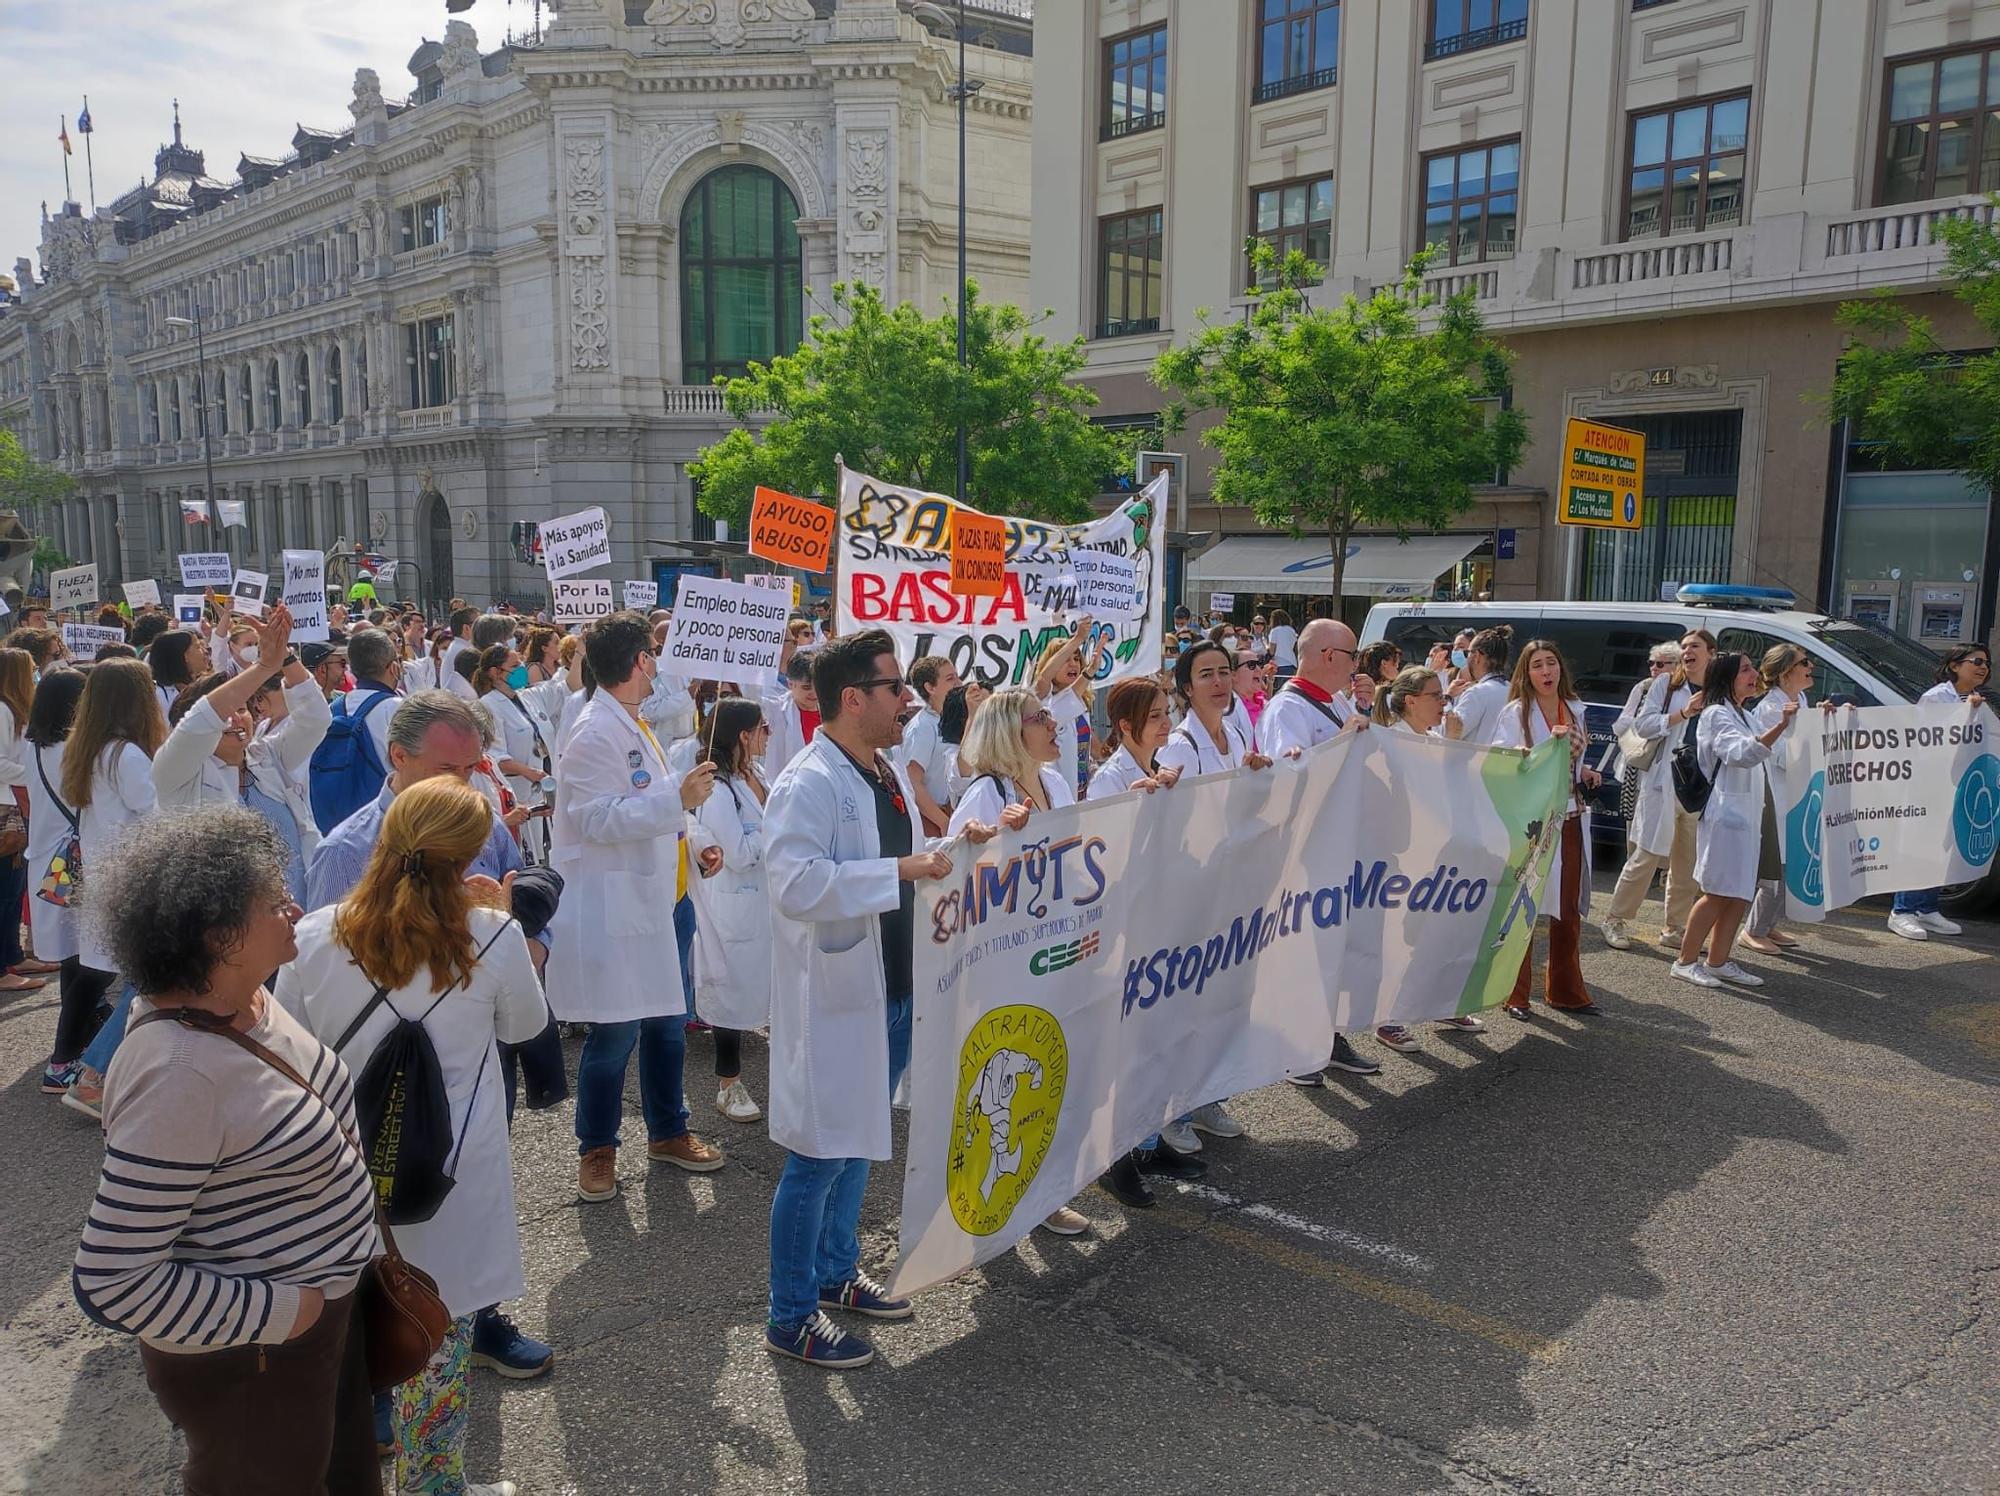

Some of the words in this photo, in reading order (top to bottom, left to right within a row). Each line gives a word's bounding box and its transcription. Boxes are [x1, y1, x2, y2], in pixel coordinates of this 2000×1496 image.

[1651, 371, 1670, 385] 44
[1610, 456, 1617, 466] de
[1619, 457, 1636, 470] Cubas
[1570, 469, 1599, 483] CORTADA
[1602, 473, 1613, 485] POR
[1617, 476, 1637, 488] OBRAS
[1575, 489, 1596, 502] Acceso
[1599, 495, 1608, 505] por
[756, 500, 830, 538] ¡AYUSO,
[544, 526, 568, 552] ¡Más
[570, 519, 604, 542] apoyos
[754, 525, 827, 560] ABUSO!
[550, 560, 556, 571] a
[556, 553, 566, 567] la
[567, 538, 609, 564] Sanidad!
[58, 573, 94, 589] FIJEZA
[304, 563, 320, 579] más
[1100, 562, 1133, 579] basura
[69, 588, 82, 598] YA
[554, 584, 589, 600] ¡Por
[595, 583, 610, 596] la
[1024, 573, 1043, 597] DE
[1090, 581, 1136, 595] personal
[285, 591, 323, 606] contratos
[556, 603, 612, 616] SALUD!
[683, 590, 737, 615] Empleo
[740, 595, 786, 621] basura
[1087, 595, 1097, 606] tu
[1100, 596, 1132, 611] salud.
[292, 612, 321, 630] asura!
[674, 619, 687, 636] y
[688, 619, 724, 638] poco
[727, 625, 785, 645] personal
[672, 641, 719, 663] dañan
[723, 647, 735, 664] tu
[739, 649, 777, 668] salud.
[1904, 727, 1944, 748] POR
[1949, 724, 1983, 745] SUS
[1827, 760, 1912, 786] DERECHOS
[961, 835, 1107, 934] AMYTS
[984, 940, 989, 957] Y
[1032, 916, 1076, 941] SUPERIORES
[1121, 860, 1488, 1023] #StopMaltratMedico
[384, 1116, 403, 1173] STREET
[1014, 1116, 1055, 1192] PACIENTES
